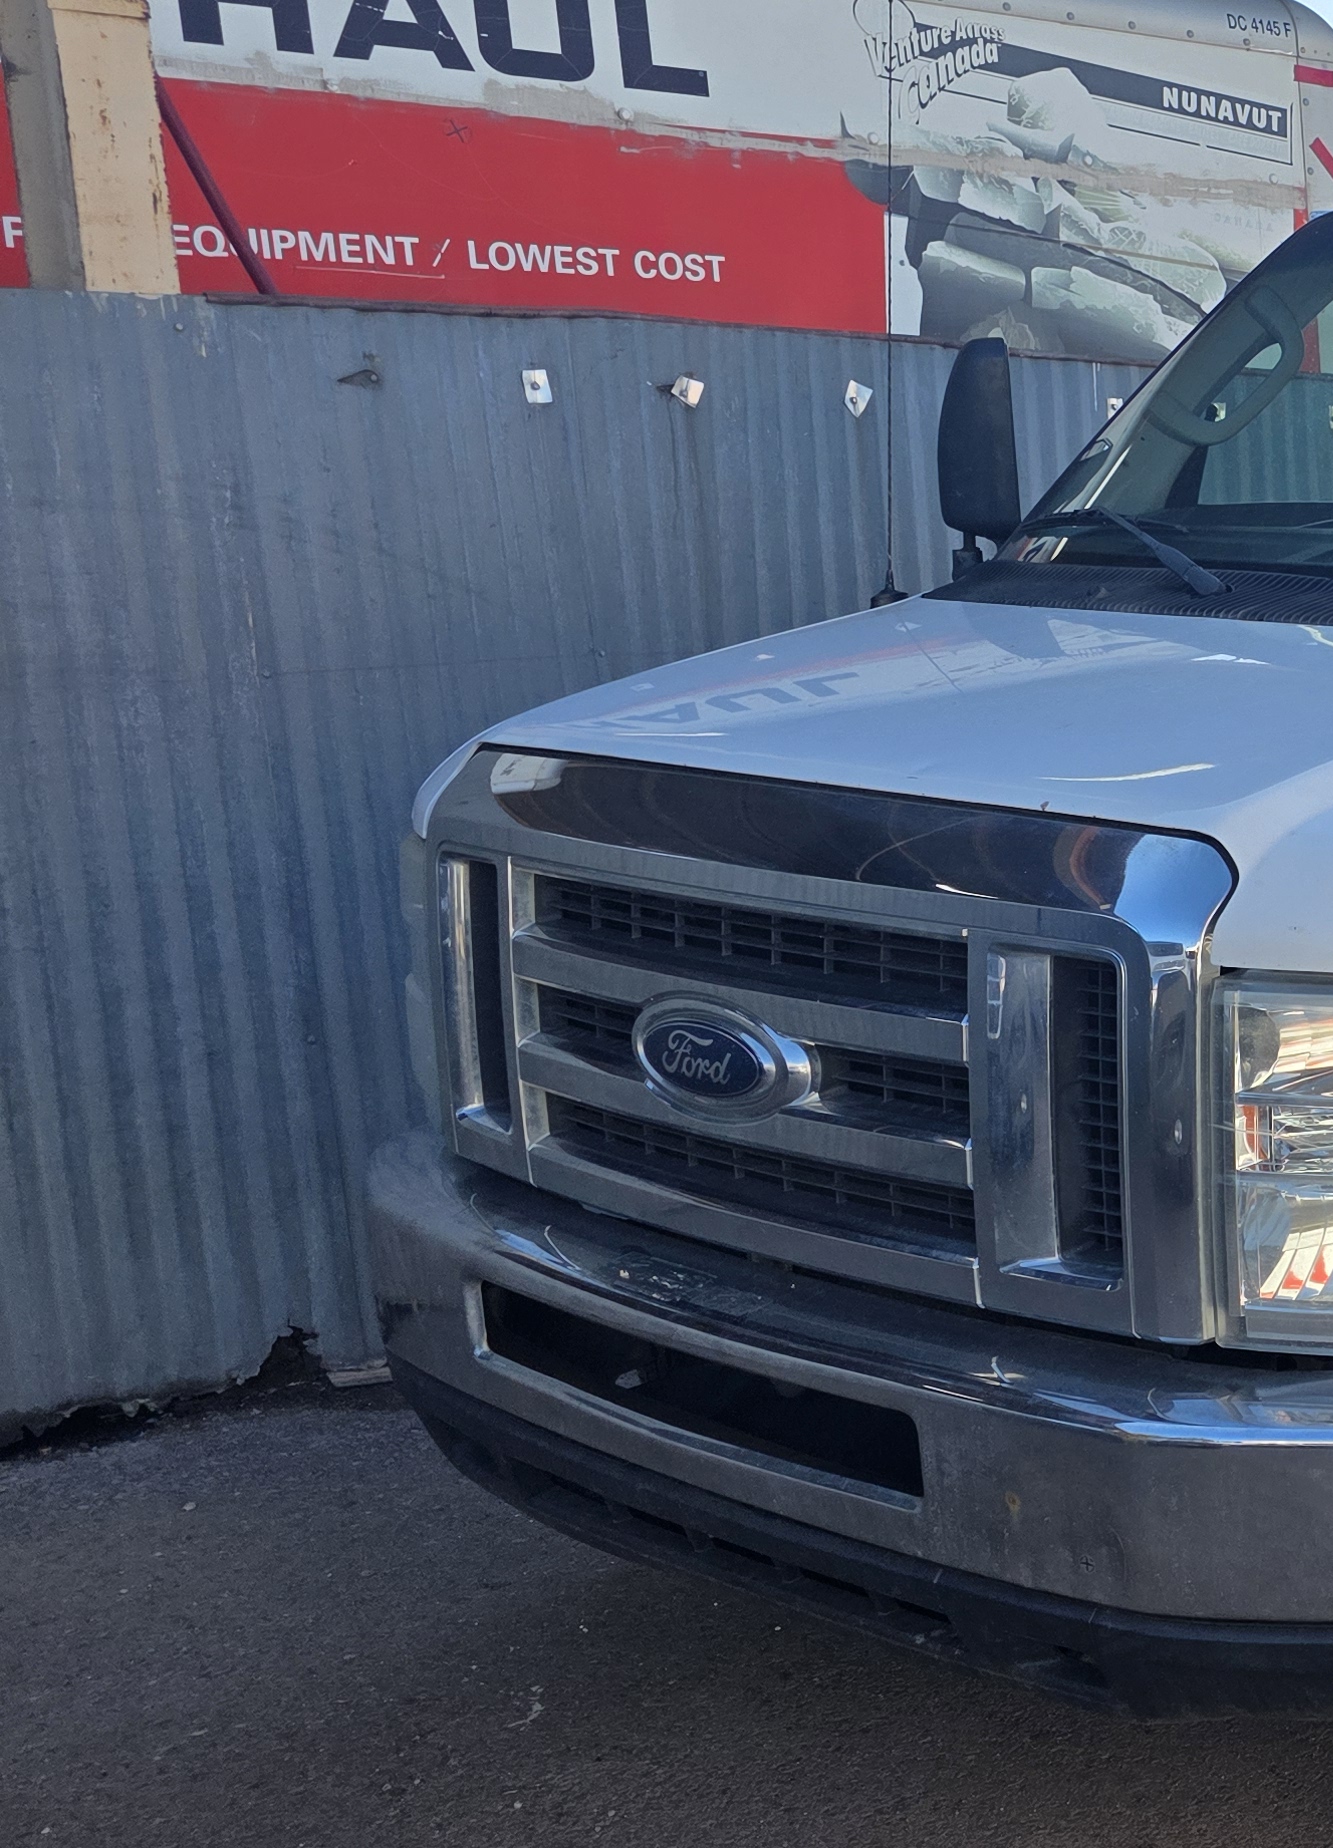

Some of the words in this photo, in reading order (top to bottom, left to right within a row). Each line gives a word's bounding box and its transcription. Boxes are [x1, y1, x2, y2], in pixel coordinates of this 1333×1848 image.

[864, 26, 952, 77] Venture
[954, 16, 1006, 42] Across
[1226, 13, 1248, 32] DC
[1250, 17, 1281, 37] 4145
[1282, 21, 1292, 38] F
[898, 37, 1000, 125] Canada
[1162, 85, 1283, 133] NUNAVUT
[466, 239, 620, 277] LOWEST
[633, 249, 726, 283] COST
[661, 1029, 732, 1085] Ford
